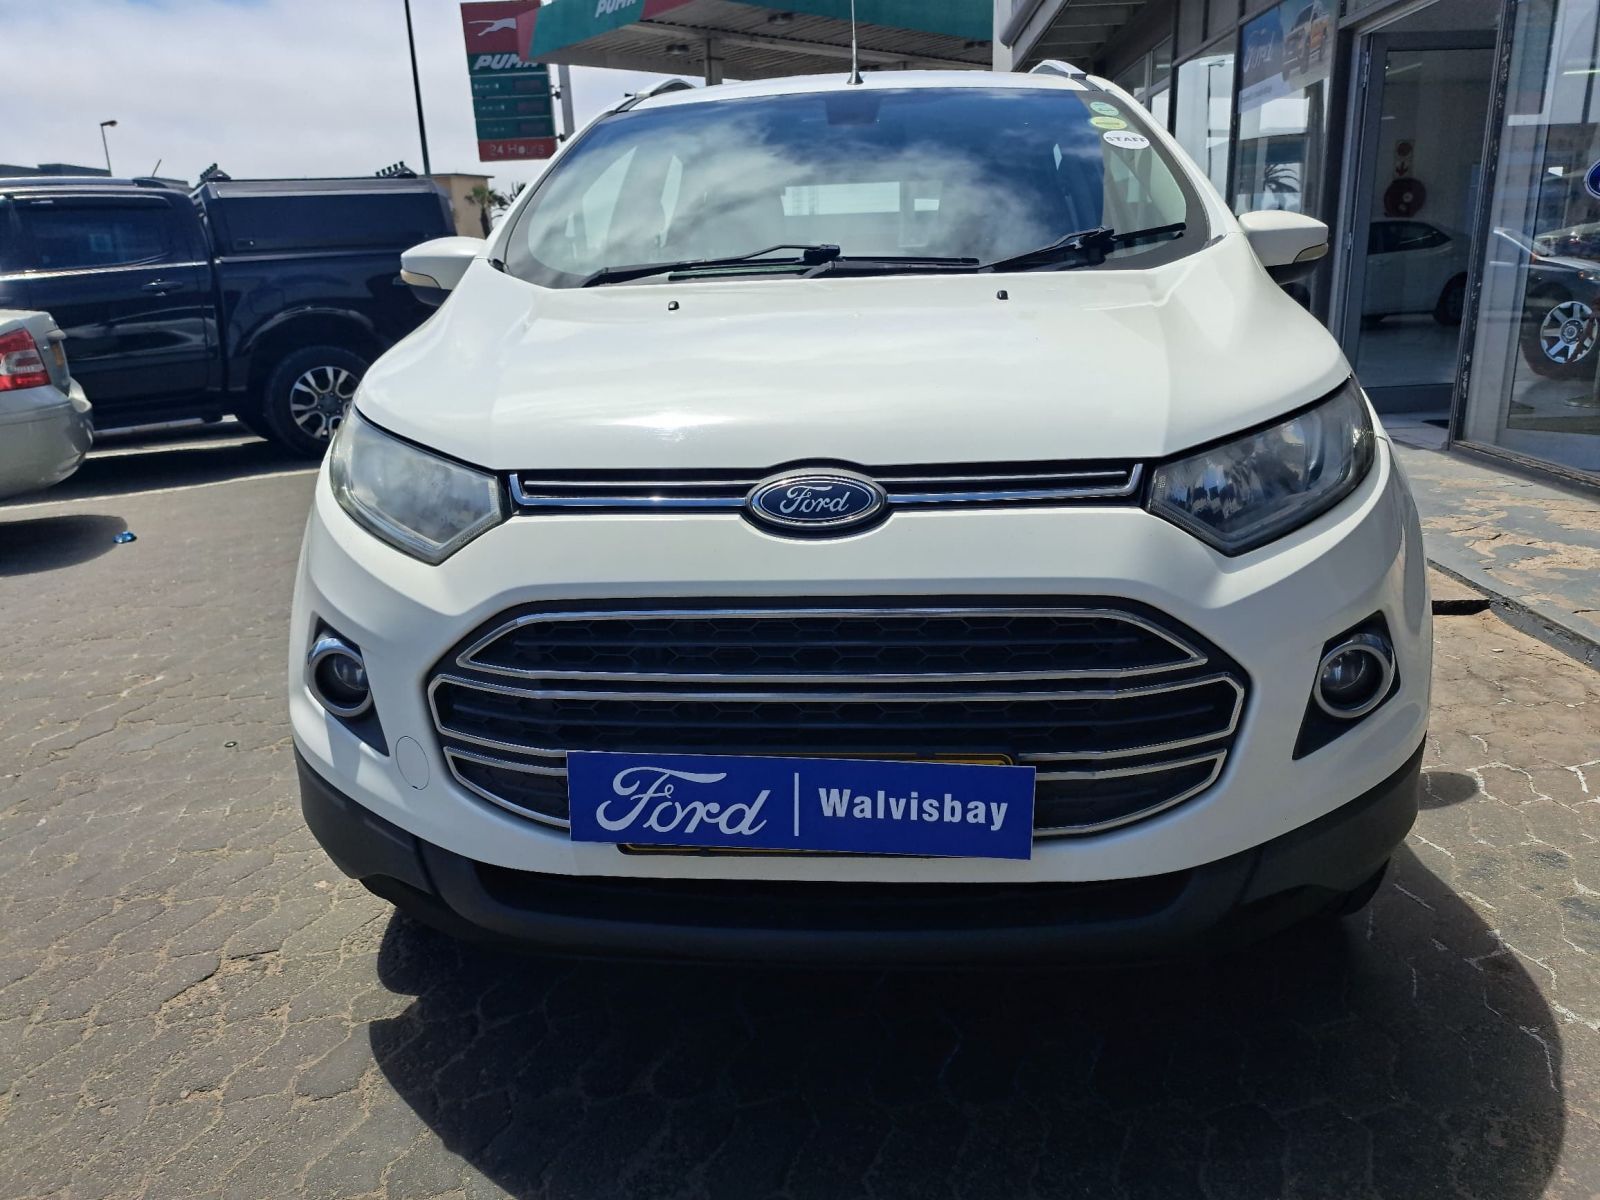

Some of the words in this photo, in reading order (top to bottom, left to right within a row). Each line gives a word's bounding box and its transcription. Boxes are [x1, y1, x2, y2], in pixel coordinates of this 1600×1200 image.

[1105, 135, 1147, 143] STAFF
[780, 485, 850, 514] Ford
[596, 766, 771, 836] Ford
[818, 787, 1008, 831] Walvisbay
